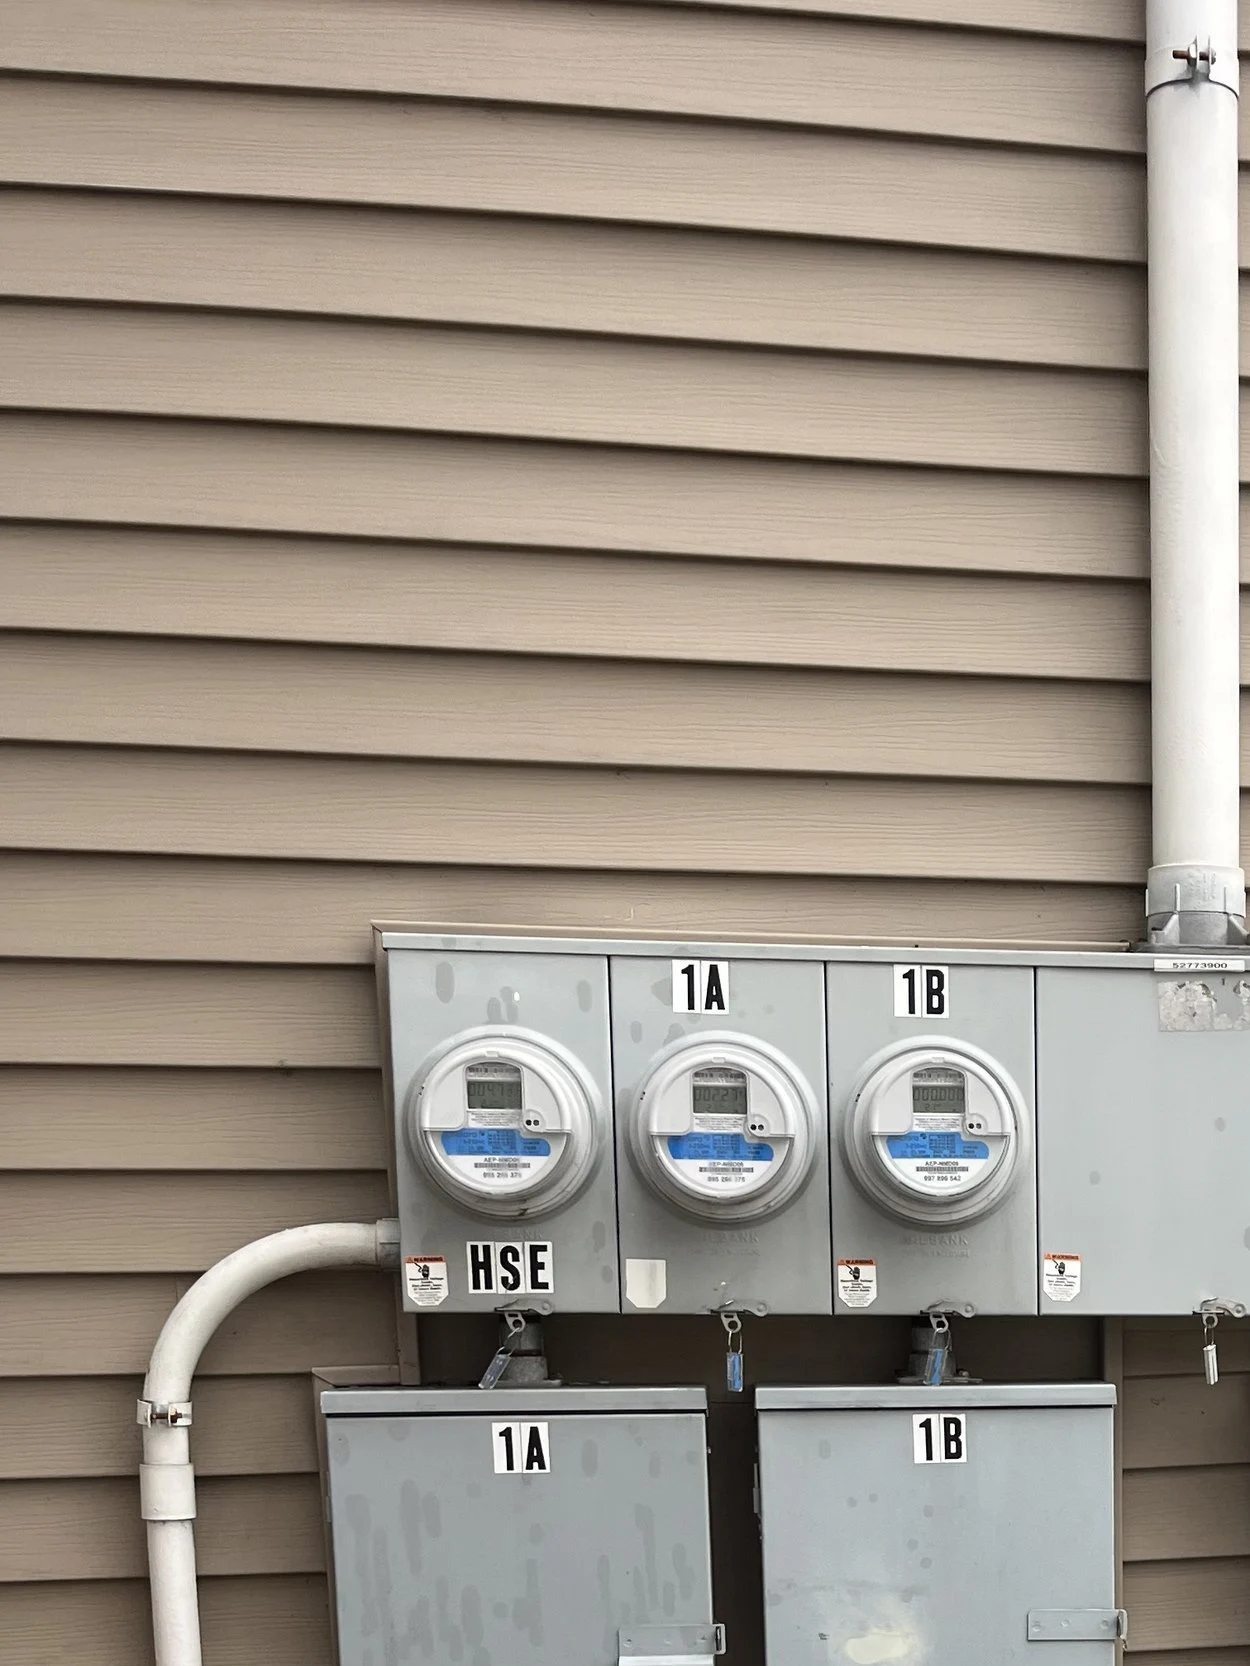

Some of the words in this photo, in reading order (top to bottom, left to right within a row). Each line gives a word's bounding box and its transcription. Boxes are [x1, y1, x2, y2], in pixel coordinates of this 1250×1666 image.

[681, 964, 725, 1010] 1A
[902, 968, 945, 1014] 1B
[470, 1244, 550, 1291] HSE
[498, 1426, 547, 1471] 1A
[919, 1416, 962, 1461] 1B
